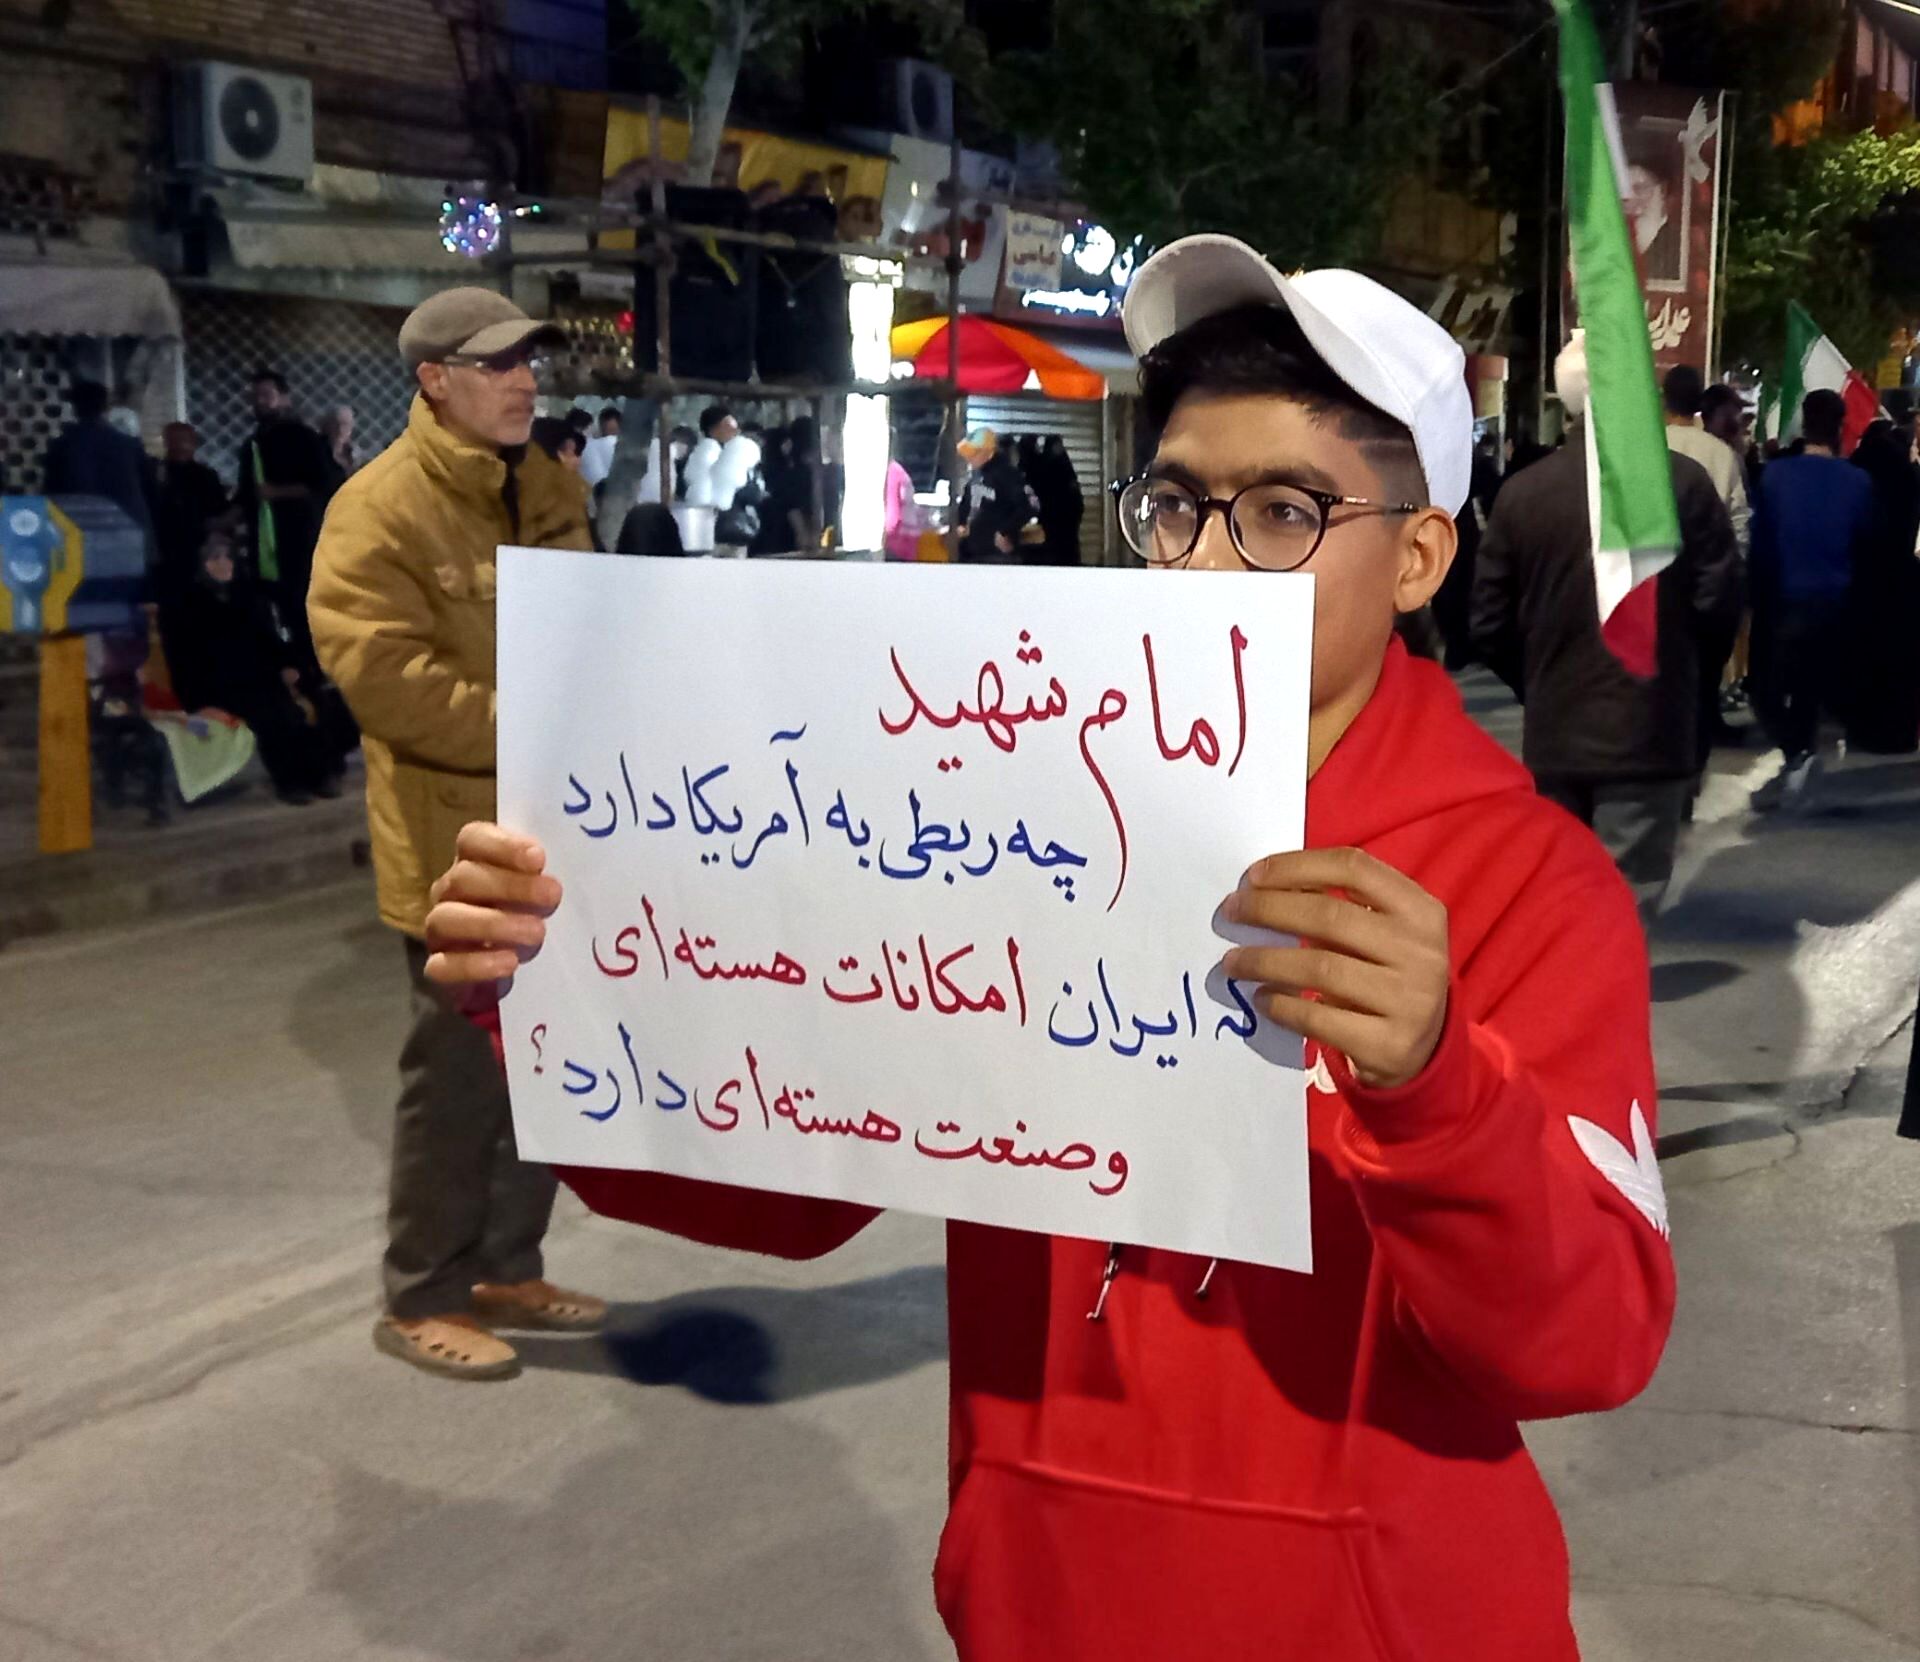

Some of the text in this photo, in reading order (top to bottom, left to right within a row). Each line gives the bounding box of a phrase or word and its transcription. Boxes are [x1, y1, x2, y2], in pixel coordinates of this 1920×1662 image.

[563, 723, 1087, 903] چه ربطی به آمریکا دارد
[879, 624, 1248, 912] امام شهید
[823, 934, 1026, 1027] امکانات
[1048, 957, 1196, 1068] ایران
